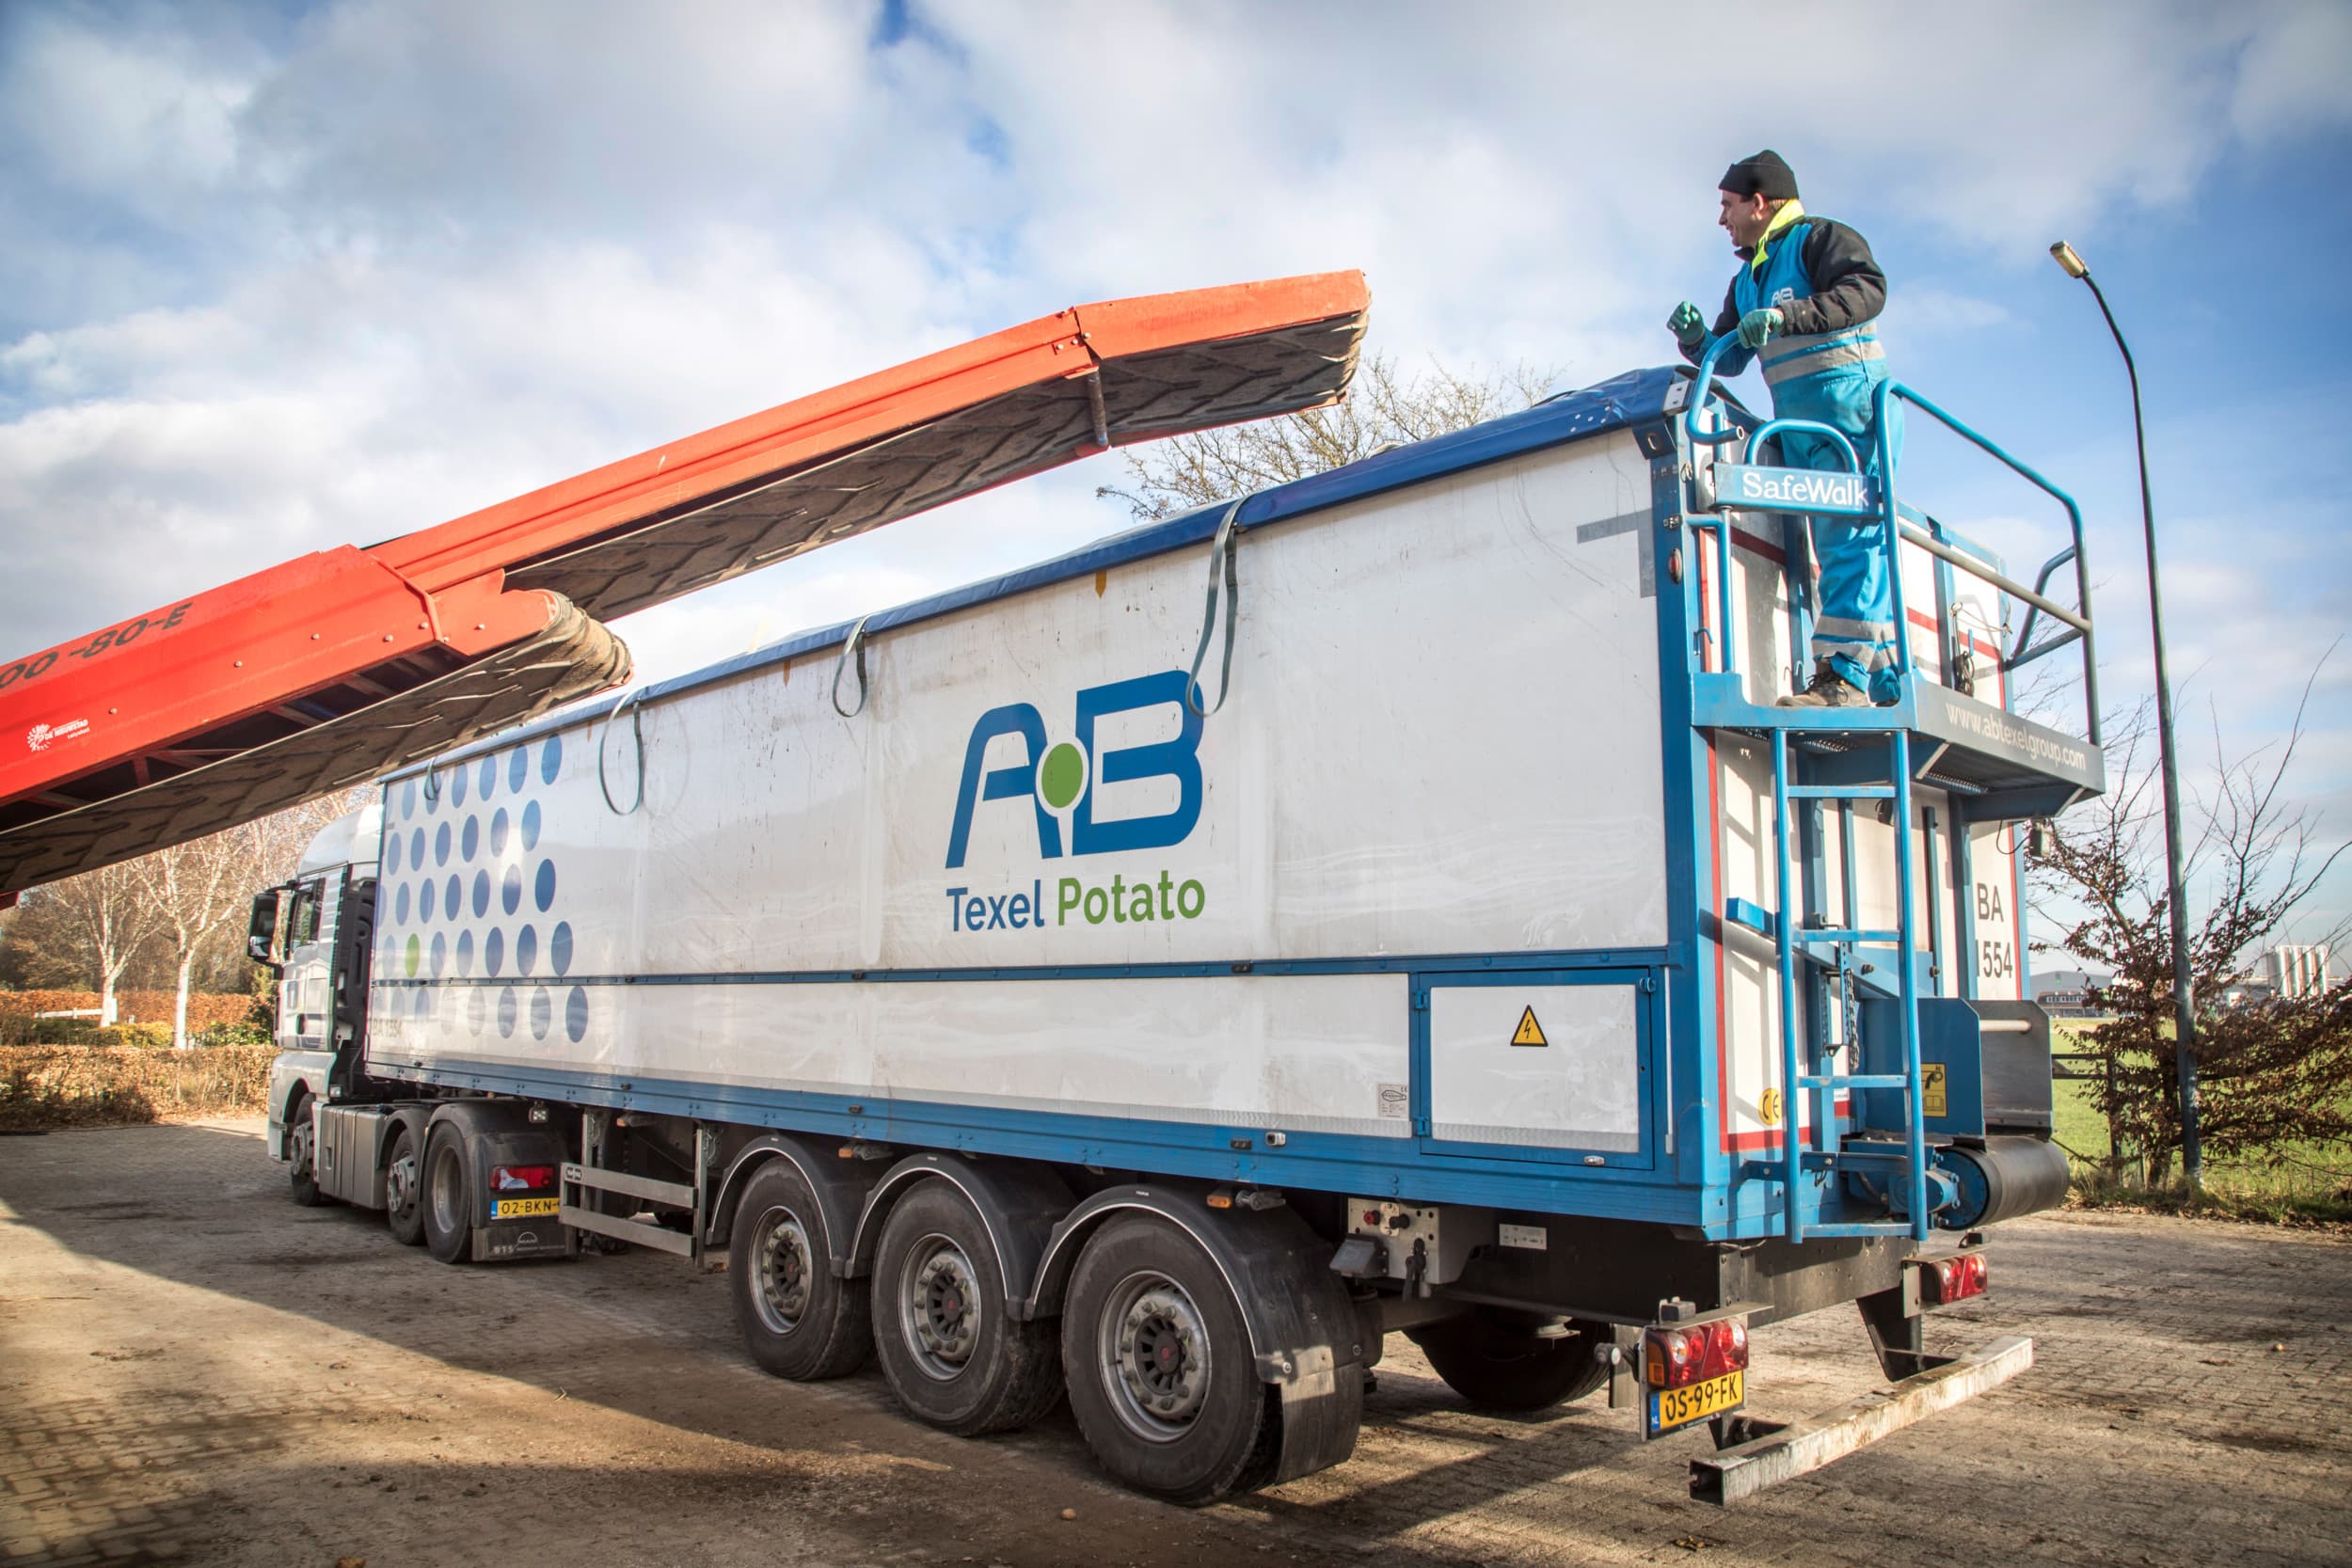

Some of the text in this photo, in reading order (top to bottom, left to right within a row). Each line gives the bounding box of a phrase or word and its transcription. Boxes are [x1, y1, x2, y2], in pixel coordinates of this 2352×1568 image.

[1771, 286, 1795, 308] AB
[1742, 471, 1869, 507] SafeWalk
[1946, 702, 2088, 773] www.abtexelgroup.com
[945, 670, 1205, 869] AB
[946, 869, 1206, 933] Texel Potato
[1977, 881, 2005, 923] BA
[1975, 938, 2013, 979] 1554
[501, 1200, 559, 1214] 02-BKN-
